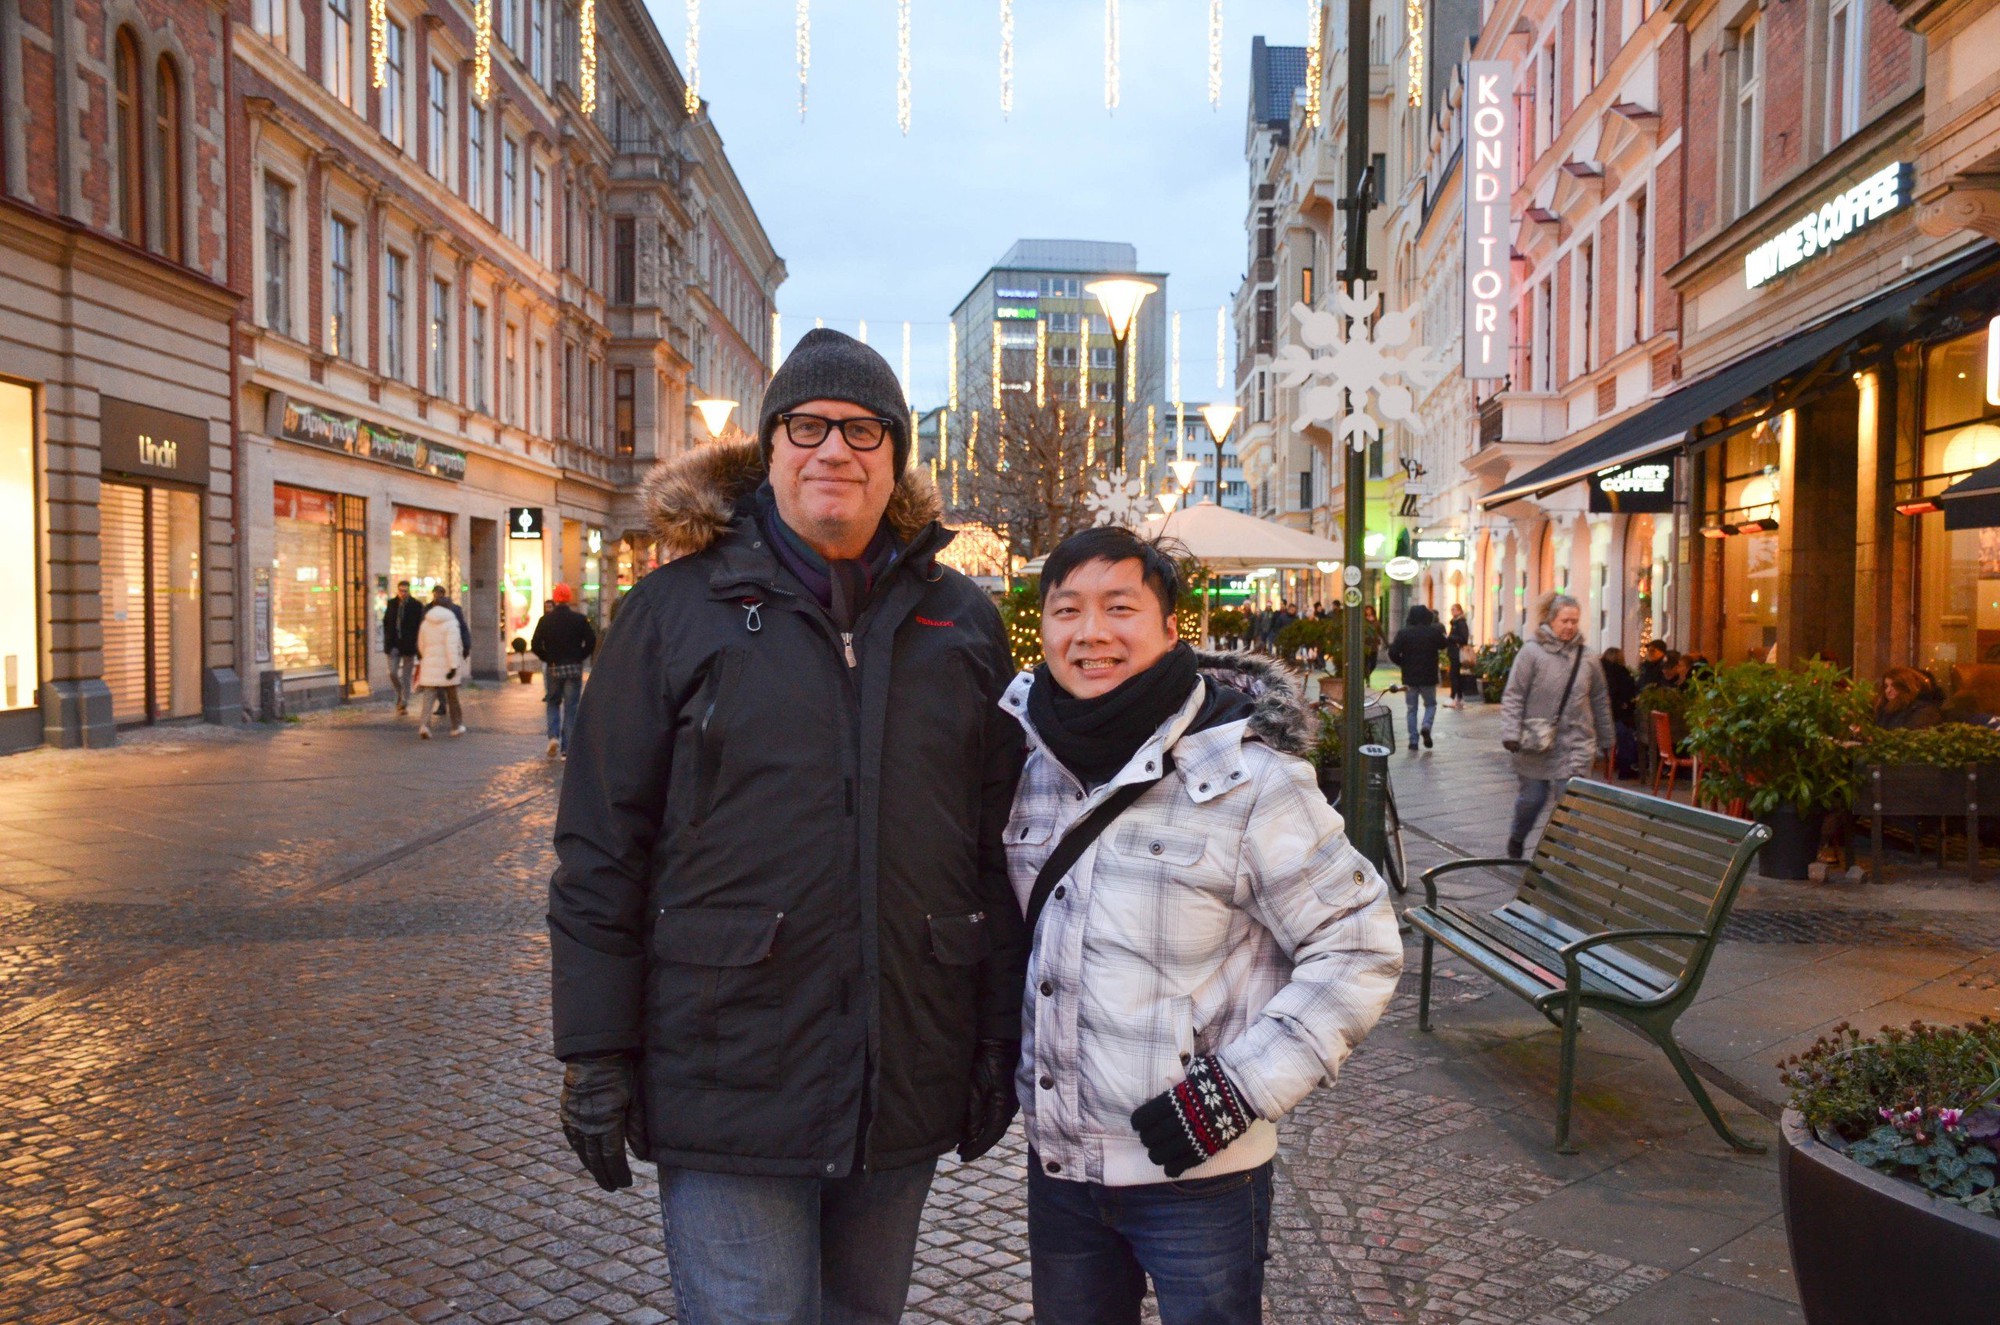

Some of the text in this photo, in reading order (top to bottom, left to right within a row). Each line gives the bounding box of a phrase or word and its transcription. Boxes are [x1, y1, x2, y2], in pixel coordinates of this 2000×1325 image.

[1472, 74, 1505, 364] KONDITORI
[1745, 161, 1900, 290] WAYNE'S COFFEE
[1600, 477, 1665, 493] COFFEE
